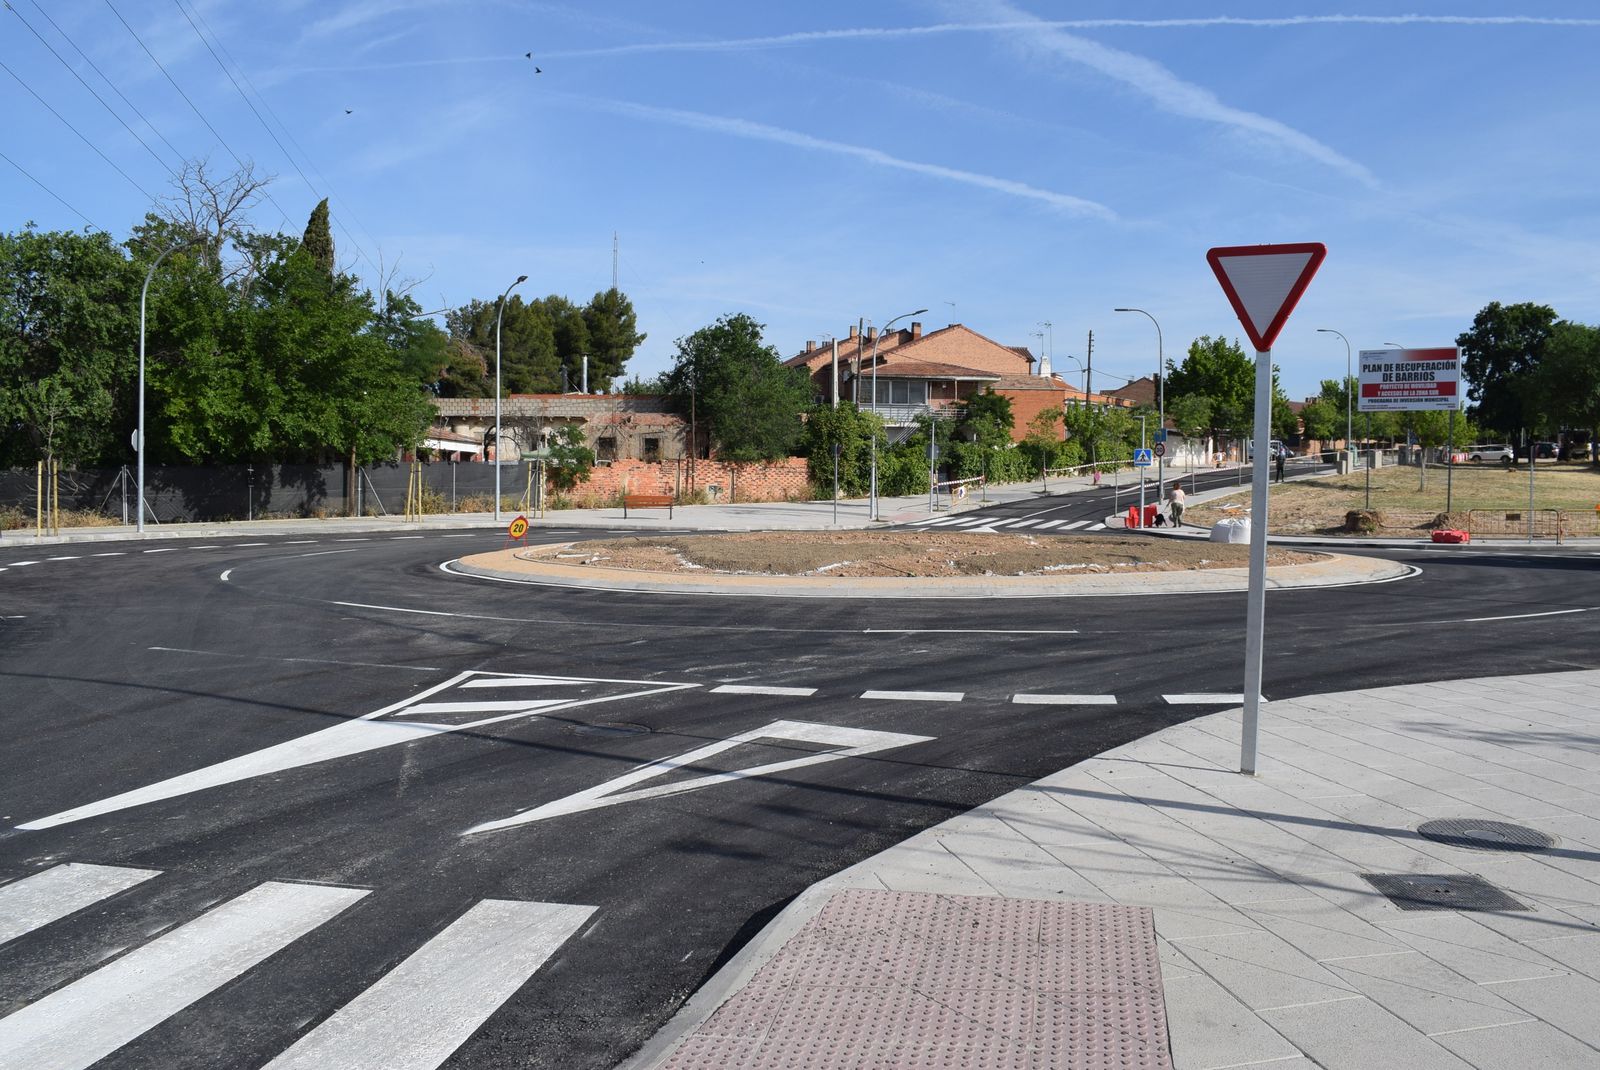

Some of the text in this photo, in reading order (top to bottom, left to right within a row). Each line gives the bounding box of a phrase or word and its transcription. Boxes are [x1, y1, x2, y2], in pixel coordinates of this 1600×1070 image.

[1362, 360, 1456, 372] PLAN DE RECUPERACIÓN
[1382, 372, 1435, 382] DE BARRIOS
[513, 524, 524, 533] 20
